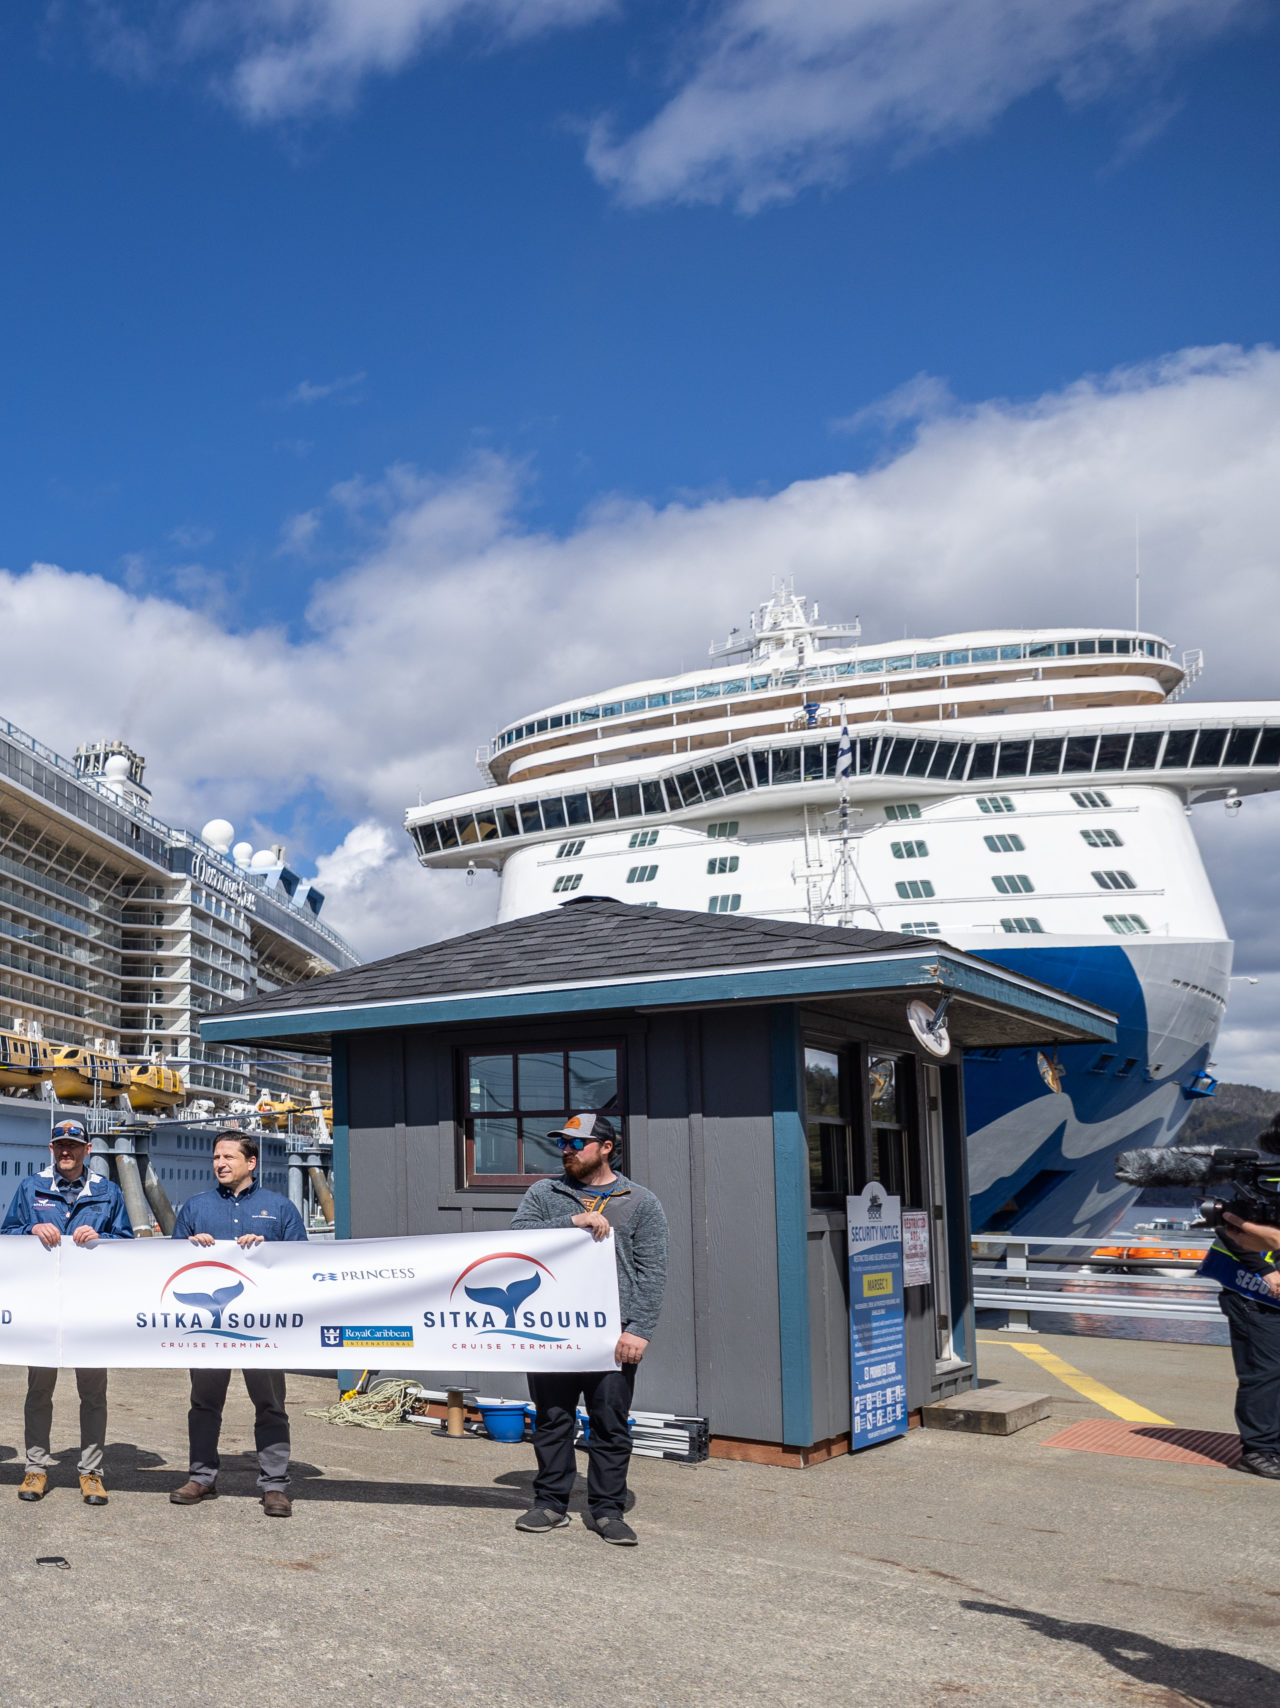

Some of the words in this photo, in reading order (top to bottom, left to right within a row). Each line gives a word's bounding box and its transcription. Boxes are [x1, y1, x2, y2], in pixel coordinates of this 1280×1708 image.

[851, 1225, 879, 1242] SECURITY
[880, 1225, 899, 1240] NOTICE
[341, 1267, 416, 1281] PRINCESS
[867, 1278, 886, 1291] MARSEC
[136, 1312, 203, 1328] SITKA
[228, 1313, 304, 1329] SOUND
[423, 1311, 496, 1328] SITKA
[523, 1311, 607, 1328] SOUND
